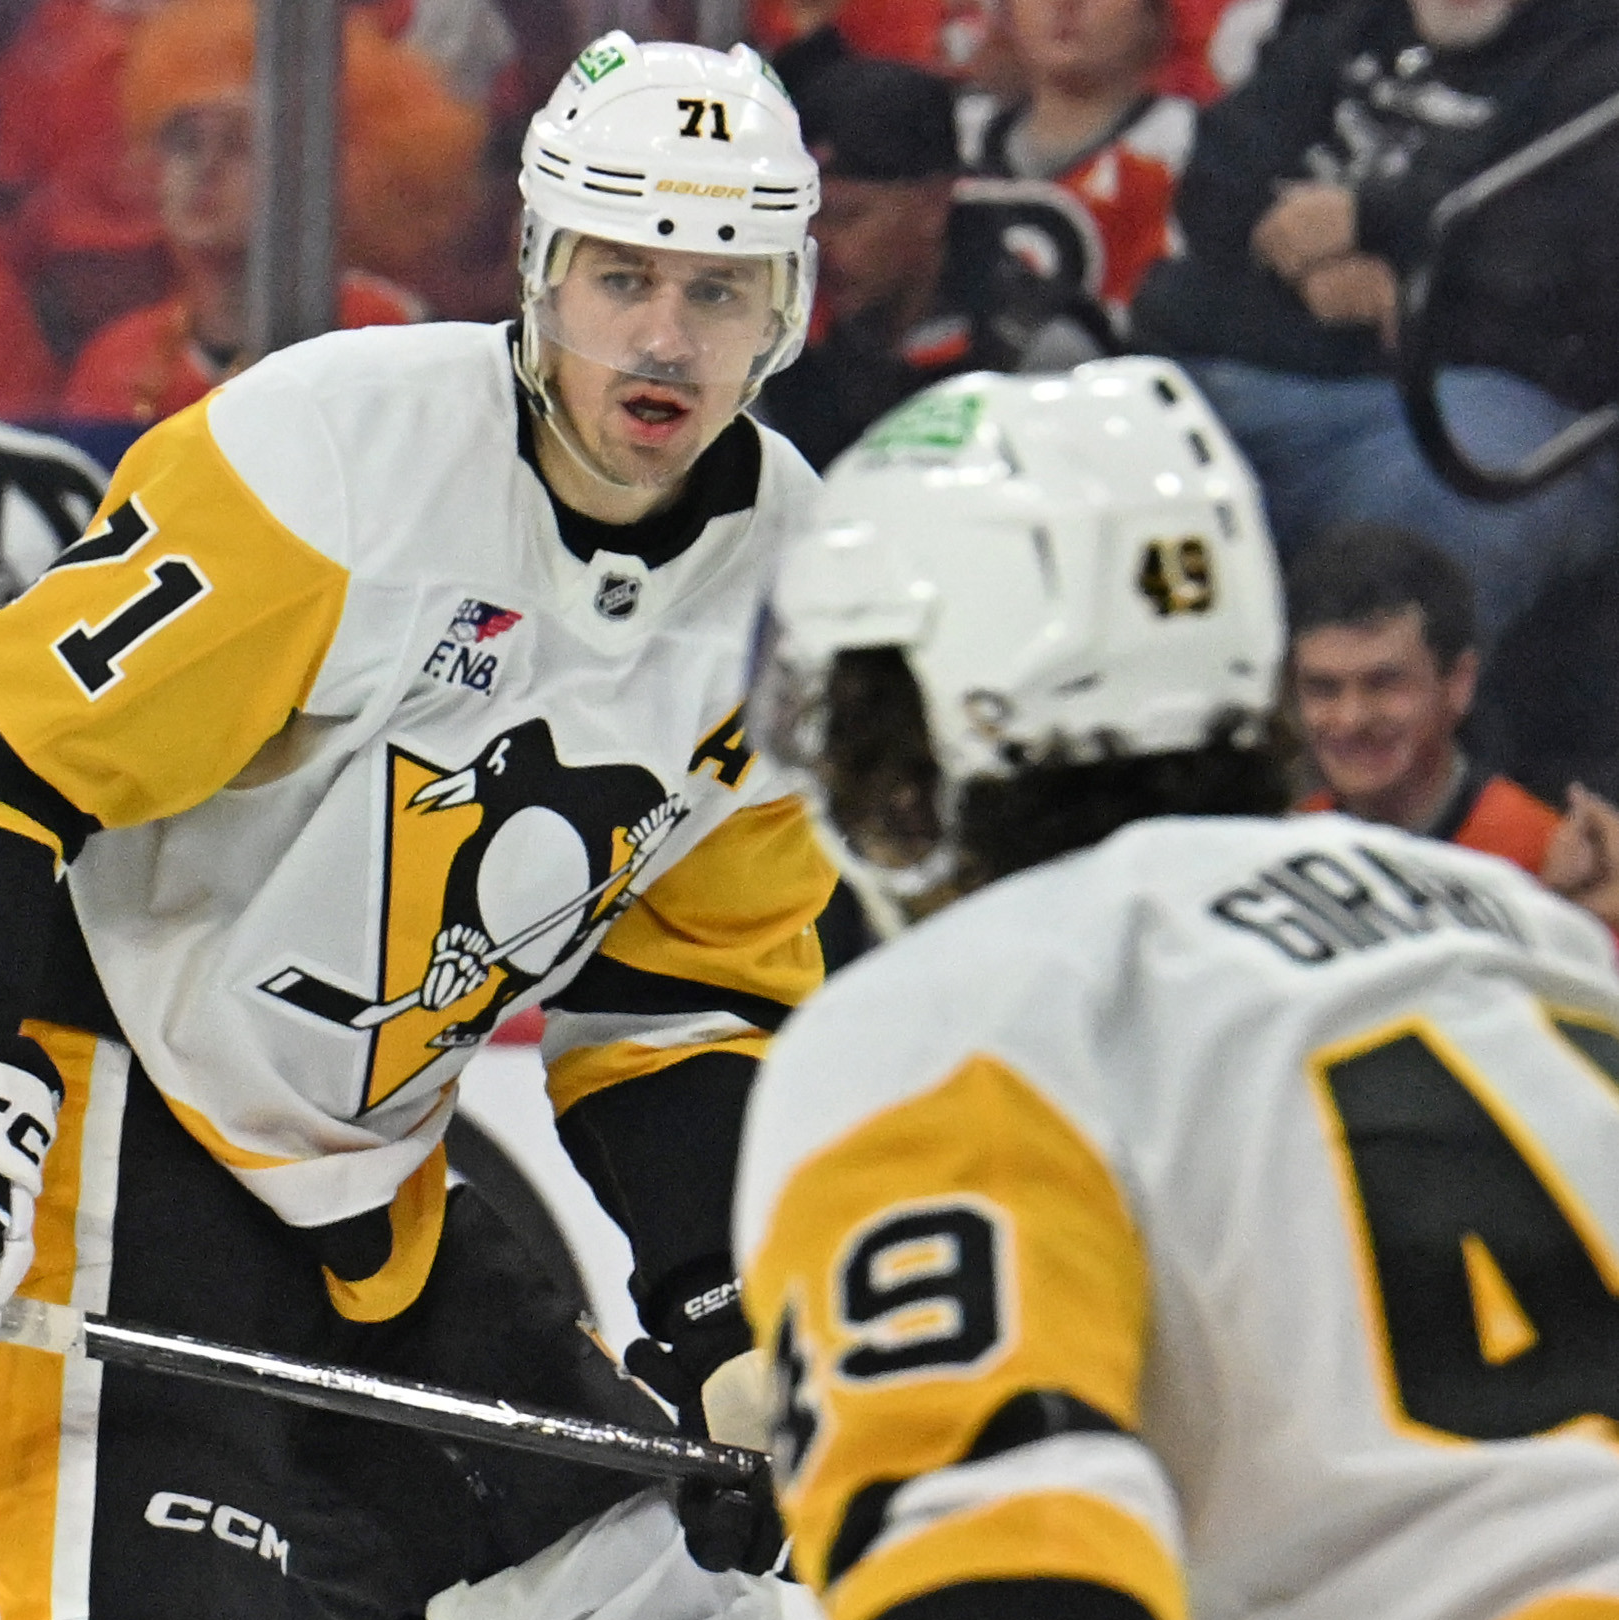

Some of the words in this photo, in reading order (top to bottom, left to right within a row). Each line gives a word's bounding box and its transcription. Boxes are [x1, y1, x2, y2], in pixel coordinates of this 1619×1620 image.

[676, 98, 732, 143] 71
[656, 179, 747, 199] BAUER
[42, 492, 213, 702] 71
[1304, 995, 1619, 1450] 4
